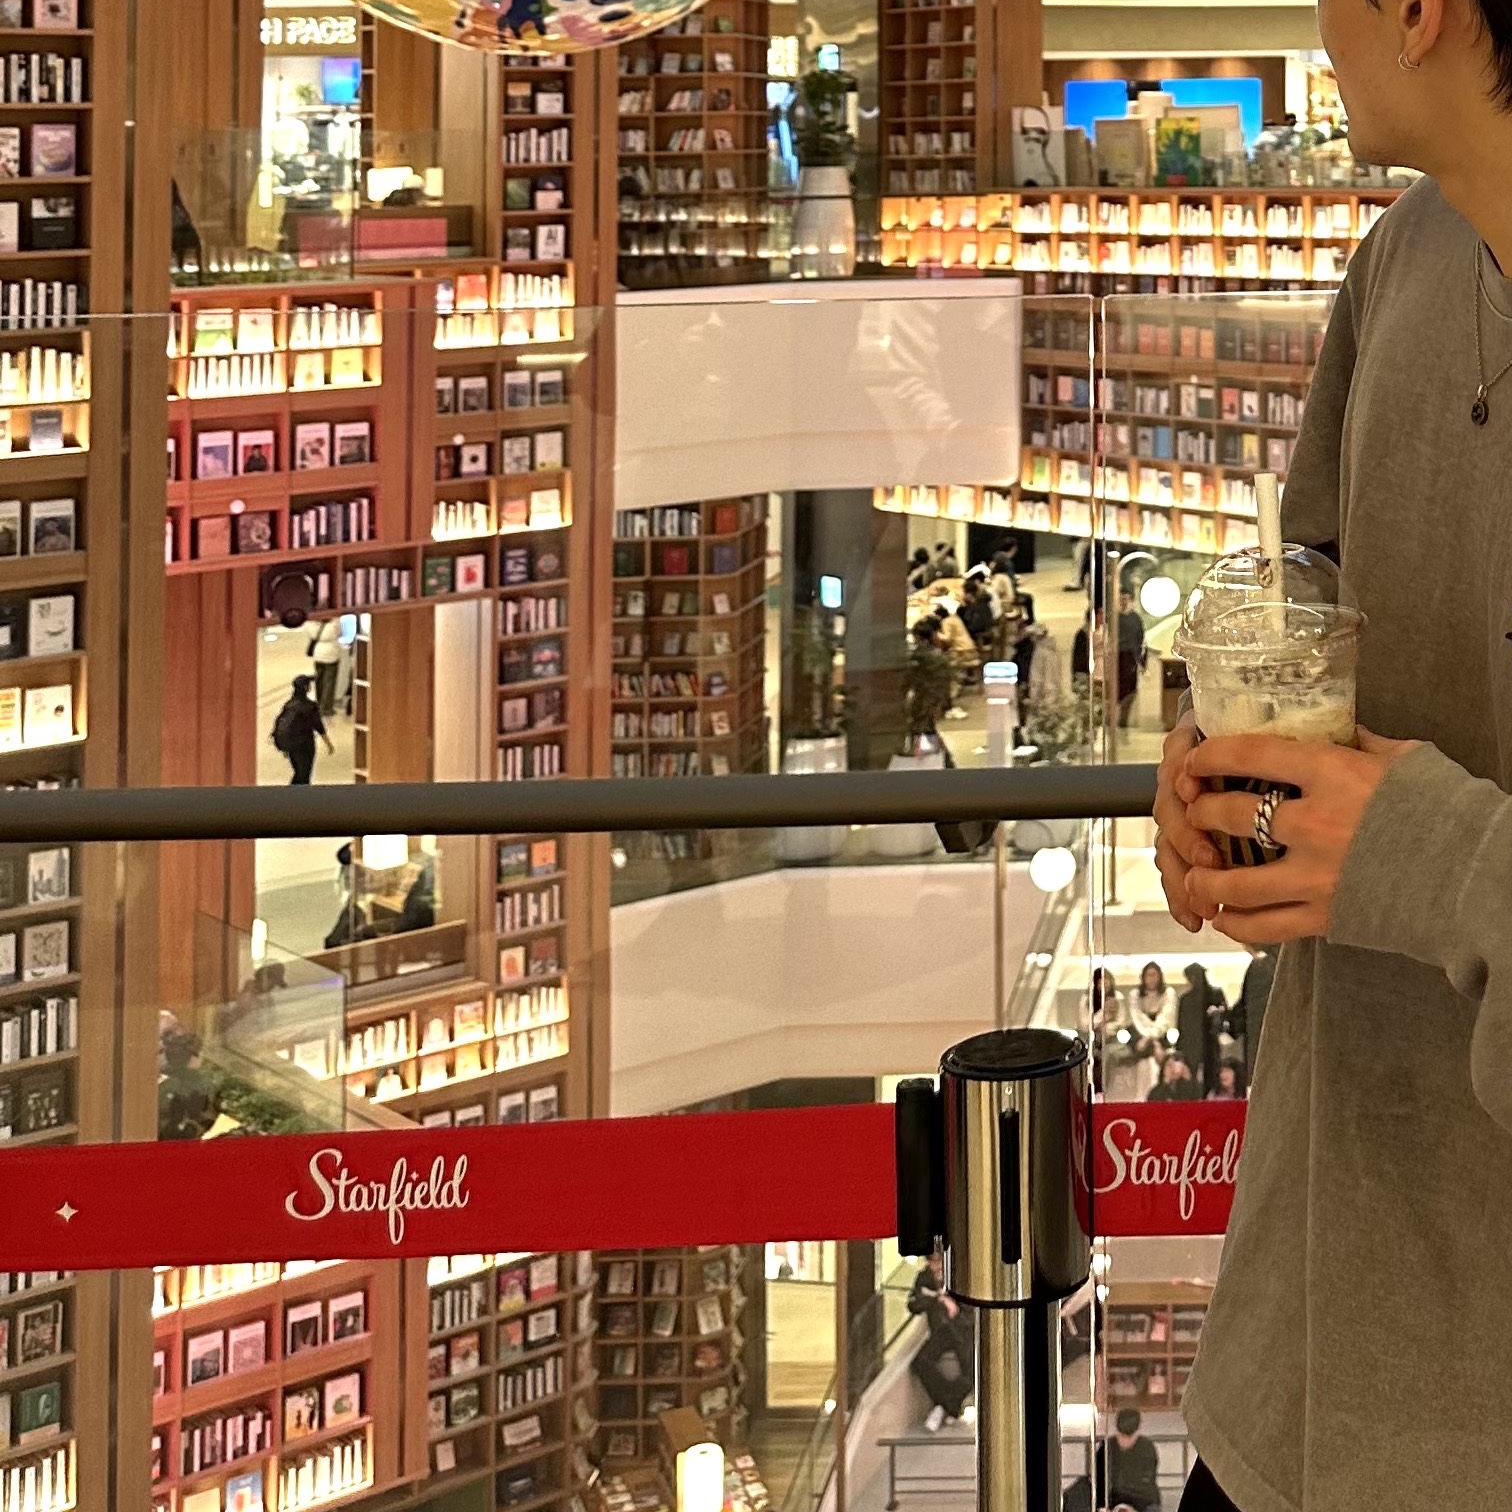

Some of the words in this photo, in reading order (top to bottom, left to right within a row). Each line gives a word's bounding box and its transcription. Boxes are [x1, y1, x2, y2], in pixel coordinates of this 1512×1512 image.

[286, 16, 357, 45] PACE
[285, 1148, 470, 1245] Starfield
[1092, 1117, 1241, 1221] Starfiel
